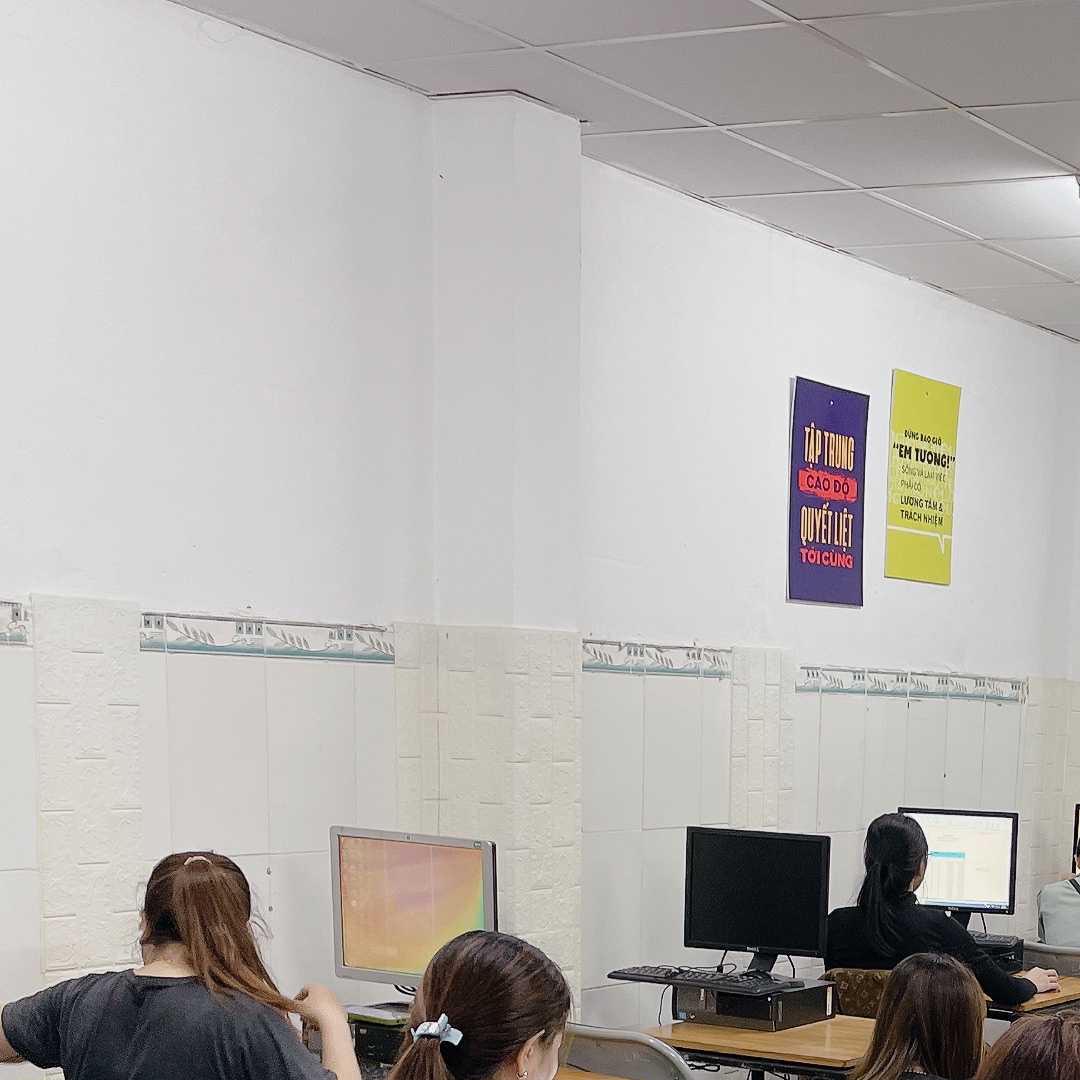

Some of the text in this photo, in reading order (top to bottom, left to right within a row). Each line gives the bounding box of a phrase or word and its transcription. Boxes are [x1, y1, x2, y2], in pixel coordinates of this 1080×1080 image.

[804, 422, 855, 471] TẬP TRUNG
[806, 474, 850, 498] CAO ĐỘ
[800, 502, 853, 552] QUYẾT LIỆT
[799, 546, 854, 569] TỚI CÙNG
